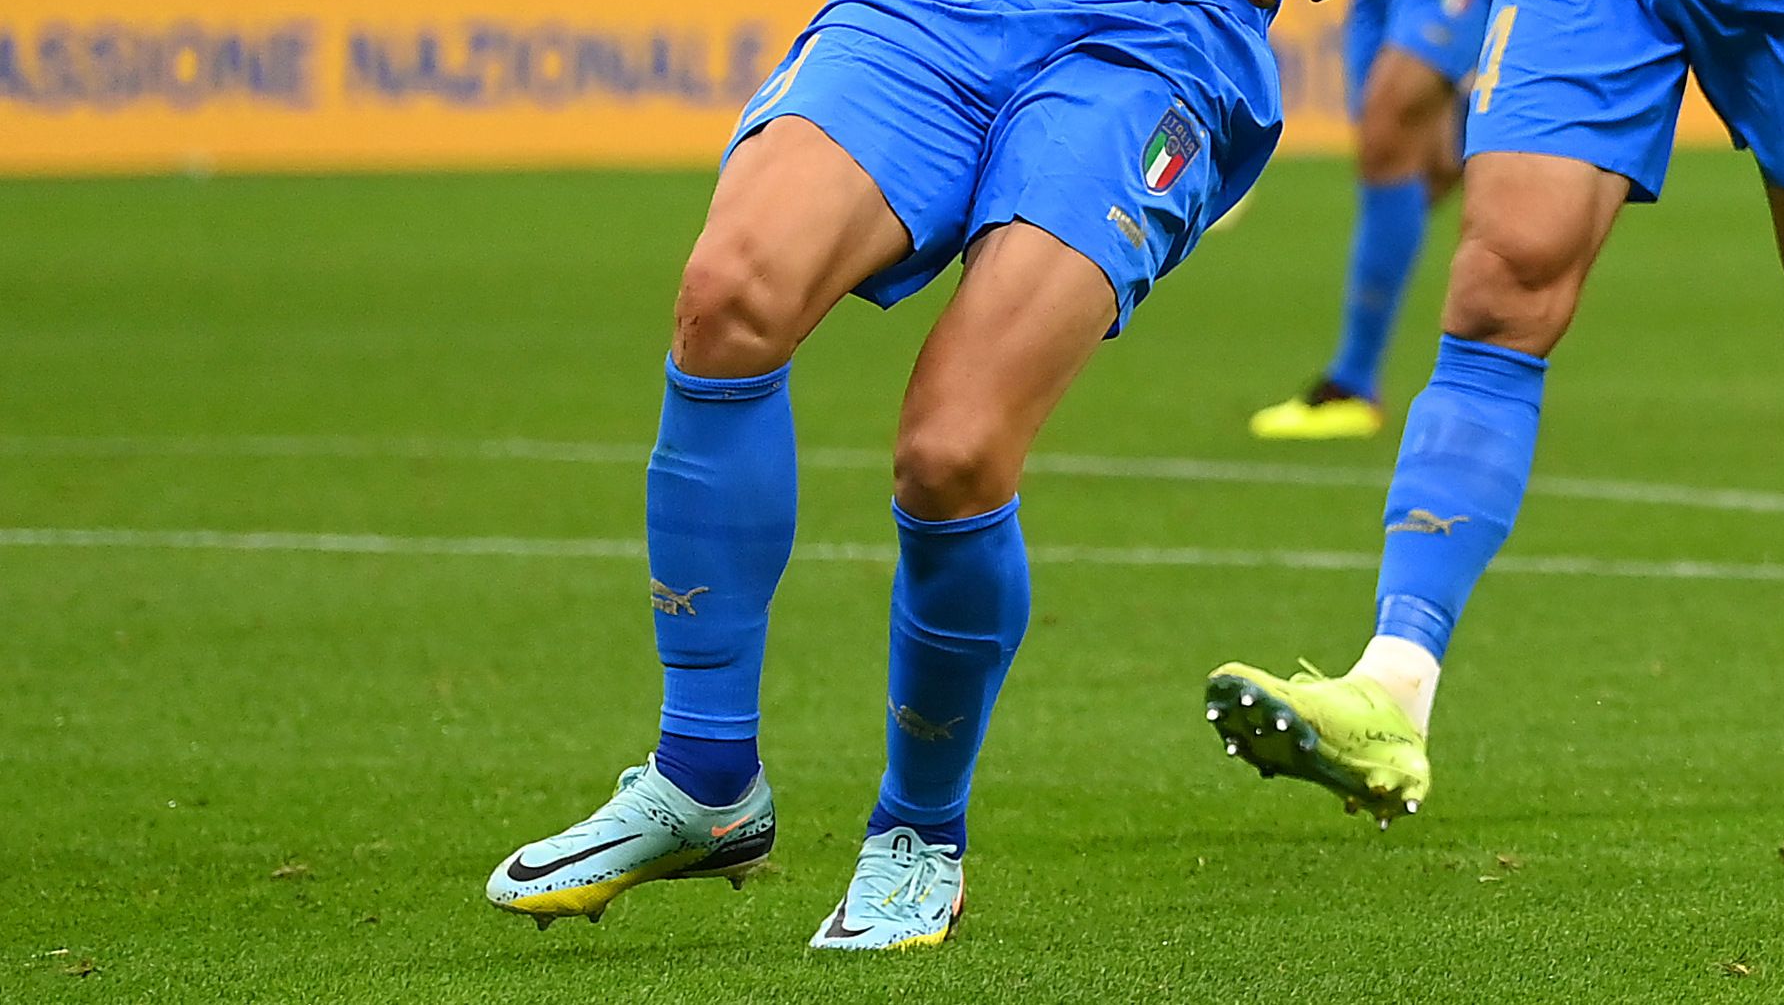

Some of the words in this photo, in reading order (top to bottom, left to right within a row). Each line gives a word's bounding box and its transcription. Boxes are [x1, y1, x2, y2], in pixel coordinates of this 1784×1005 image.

[350, 19, 770, 107] NAZIONALE
[1471, 4, 1519, 114] 4
[1164, 114, 1196, 156] ITALIA
